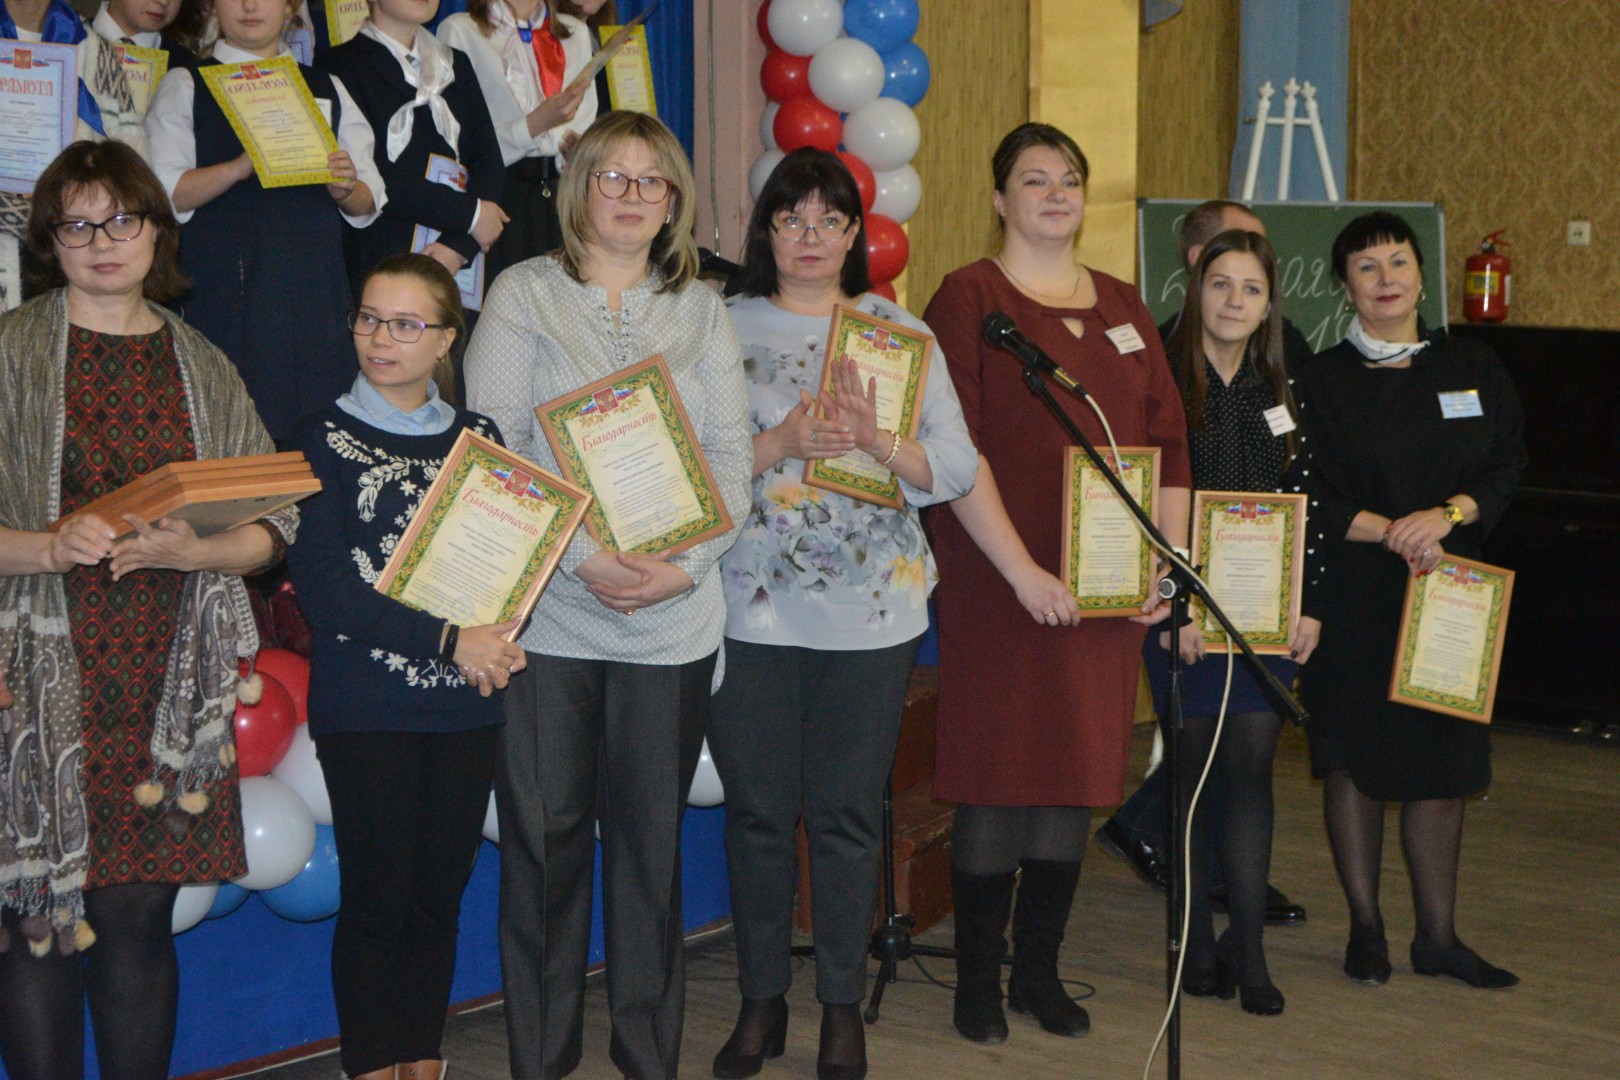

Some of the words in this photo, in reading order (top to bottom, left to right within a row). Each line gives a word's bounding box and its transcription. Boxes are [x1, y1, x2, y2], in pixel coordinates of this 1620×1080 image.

[0, 76, 54, 97] РАМОТА
[581, 411, 658, 452] Благодарность
[462, 488, 540, 537] Благодарность
